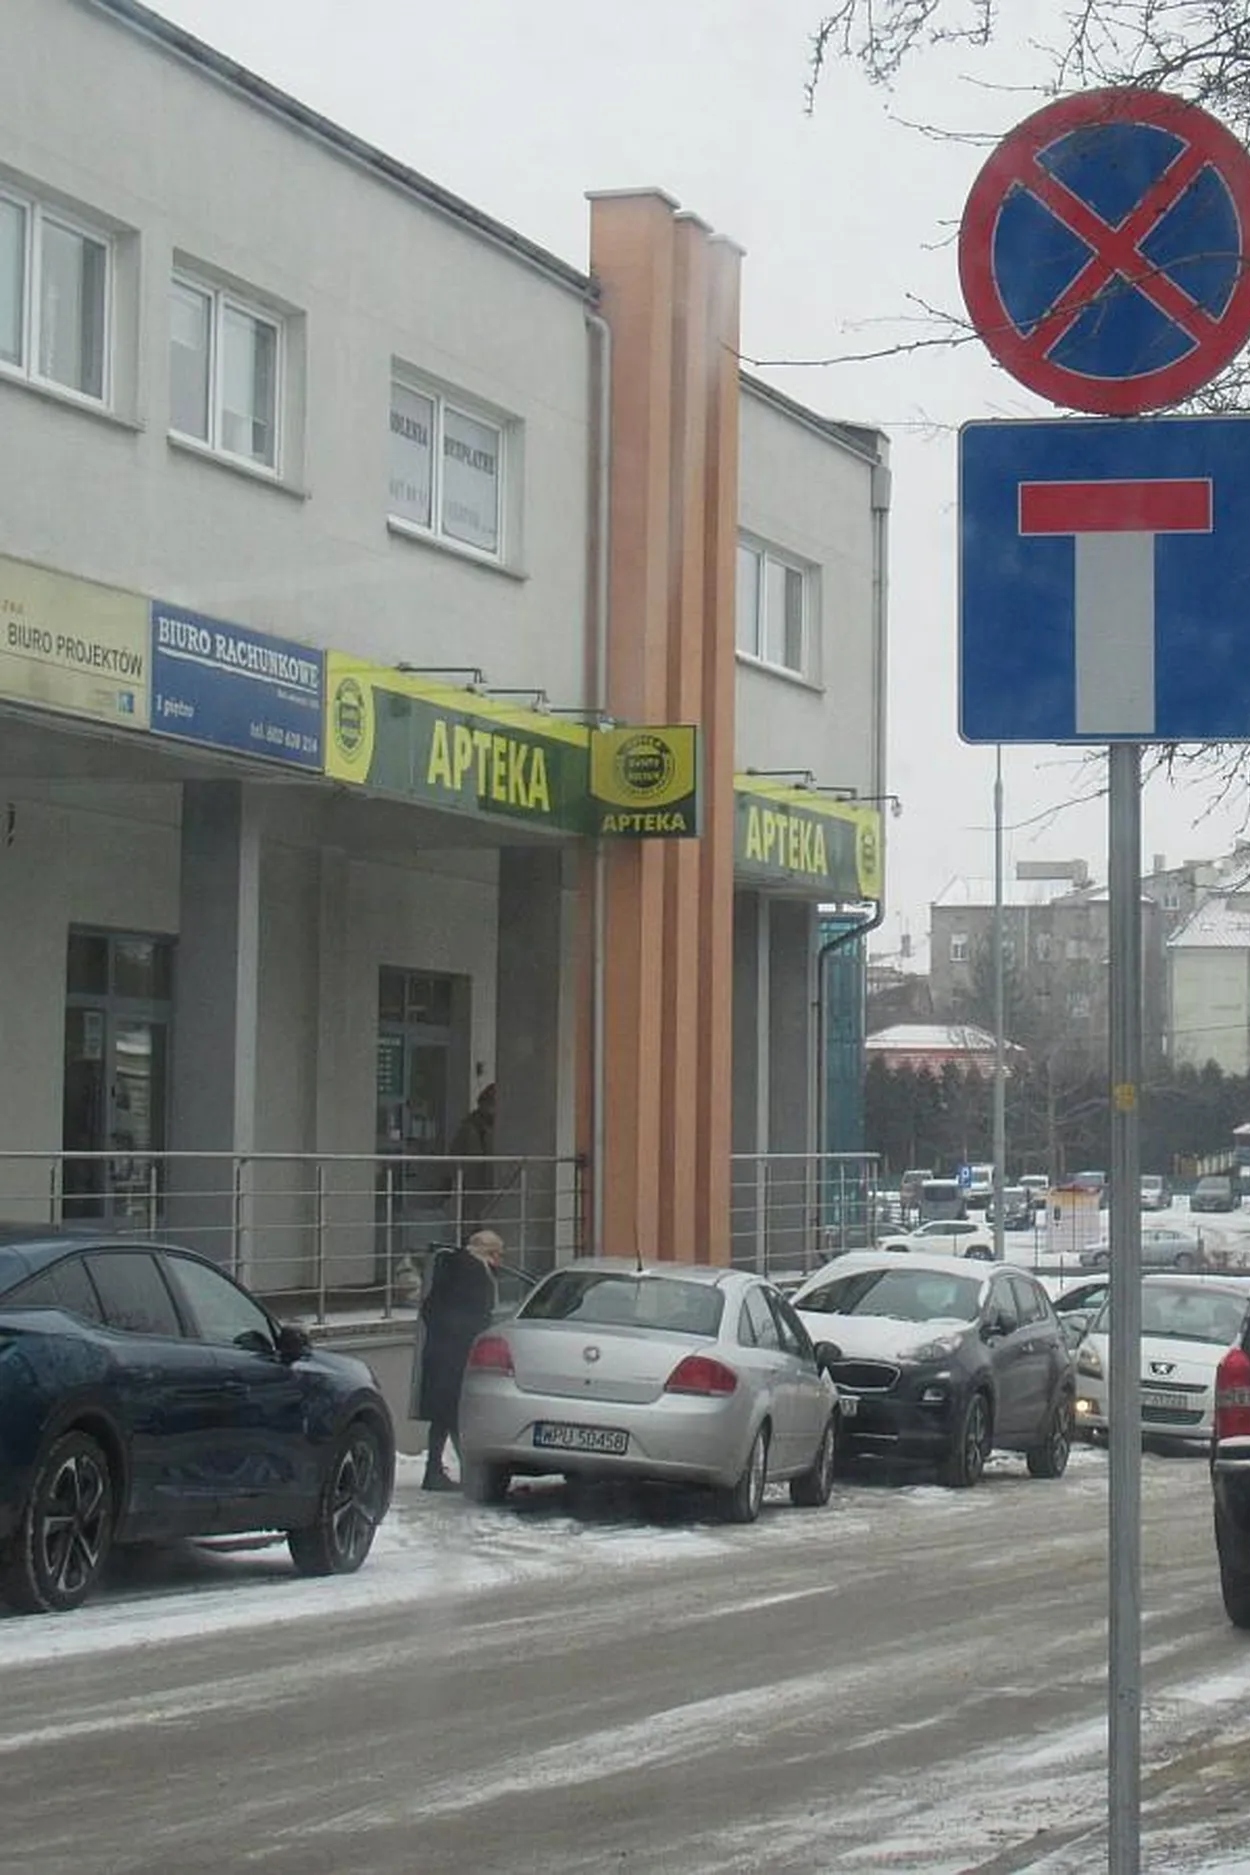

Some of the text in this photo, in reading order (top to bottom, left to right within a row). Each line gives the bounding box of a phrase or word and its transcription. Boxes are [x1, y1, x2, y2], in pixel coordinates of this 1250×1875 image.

[8, 622, 144, 679] BIURO PROJEKTÓW
[158, 616, 319, 689] BIURO RACHUNKOWE
[427, 720, 550, 812] APTEKA
[602, 812, 688, 833] APTEKA
[746, 804, 829, 876] APTEKA
[541, 1424, 574, 1445] WPU
